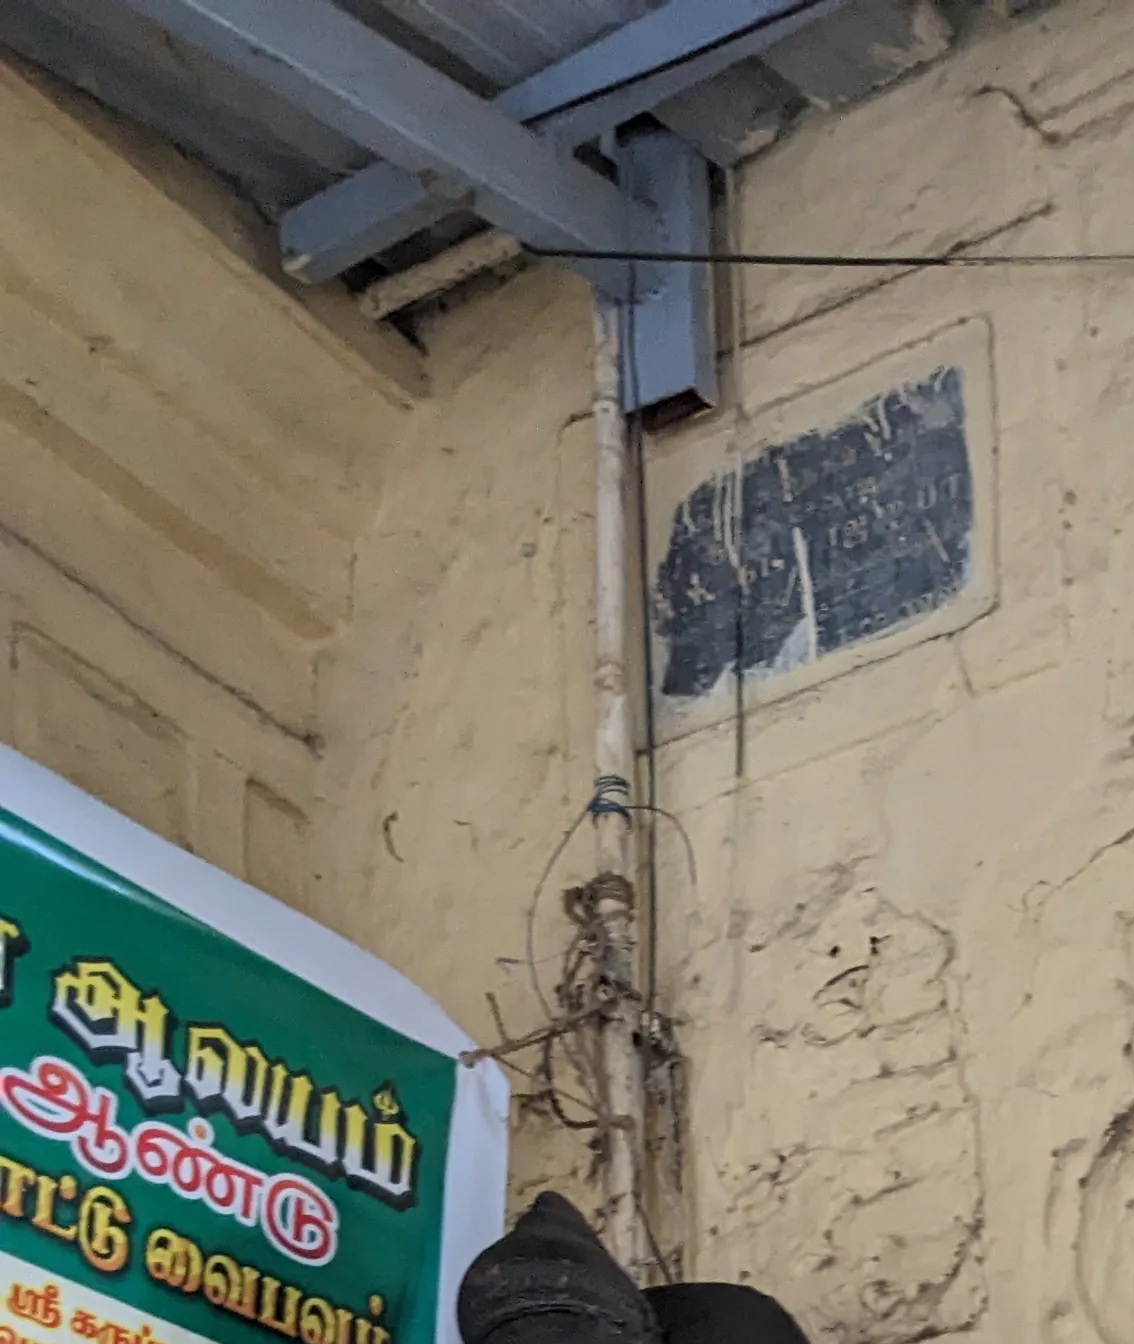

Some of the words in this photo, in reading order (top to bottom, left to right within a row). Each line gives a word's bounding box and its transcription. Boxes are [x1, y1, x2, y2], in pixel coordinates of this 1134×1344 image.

[1, 1060, 337, 1263] ஆண்டு
[53, 958, 420, 1206] ஆலயம்
[0, 1157, 131, 1273] ாட்டு
